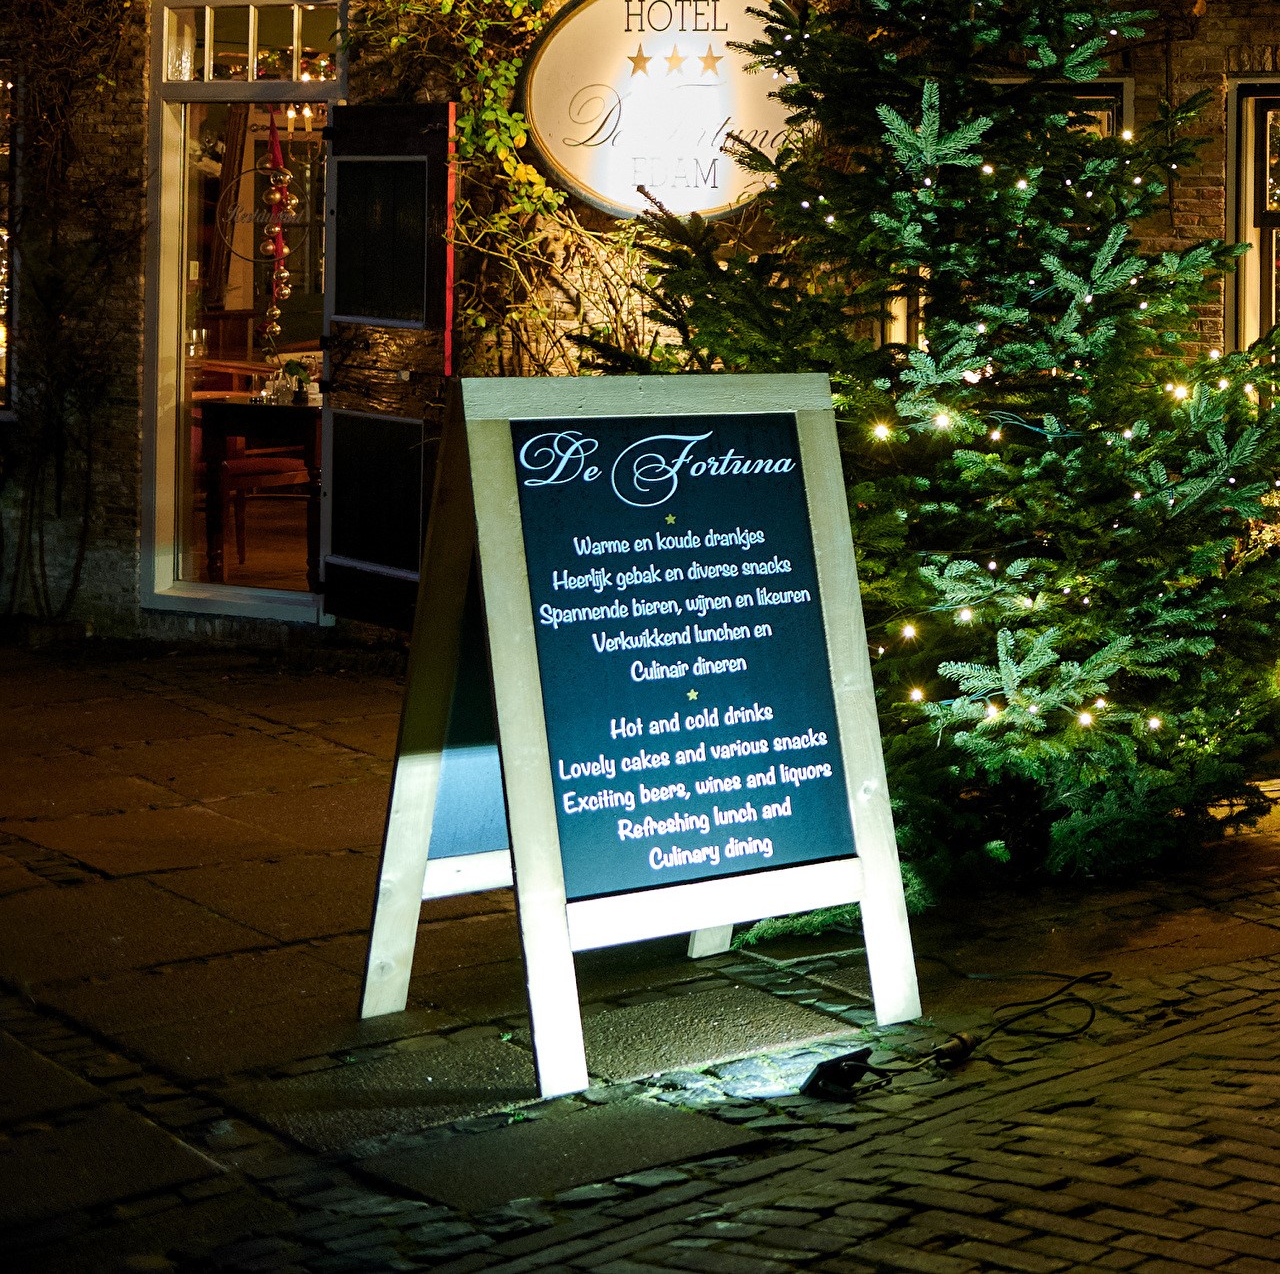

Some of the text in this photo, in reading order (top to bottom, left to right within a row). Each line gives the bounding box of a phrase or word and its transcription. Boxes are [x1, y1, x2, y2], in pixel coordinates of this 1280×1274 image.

[624, 0, 728, 32] HOTEL
[632, 157, 719, 189] EDAM
[520, 431, 795, 506] De Fortuna
[574, 527, 765, 555] Warme en koude drankjes
[553, 556, 792, 592] Heerlijk gebak en diverse snacks
[540, 587, 810, 629] Spannende bieren, wijnen en likeuren
[592, 623, 772, 652] Verkwikkend lunchen en
[631, 657, 747, 681] Culinair dineren
[611, 703, 773, 739] Hot and cold drinks
[559, 728, 827, 779] Lovely cakes and various snacks
[563, 763, 832, 813] Exciting beers, wines and liquors
[618, 796, 792, 841] Refreshing lunch and
[649, 837, 773, 870] Culinary dining
